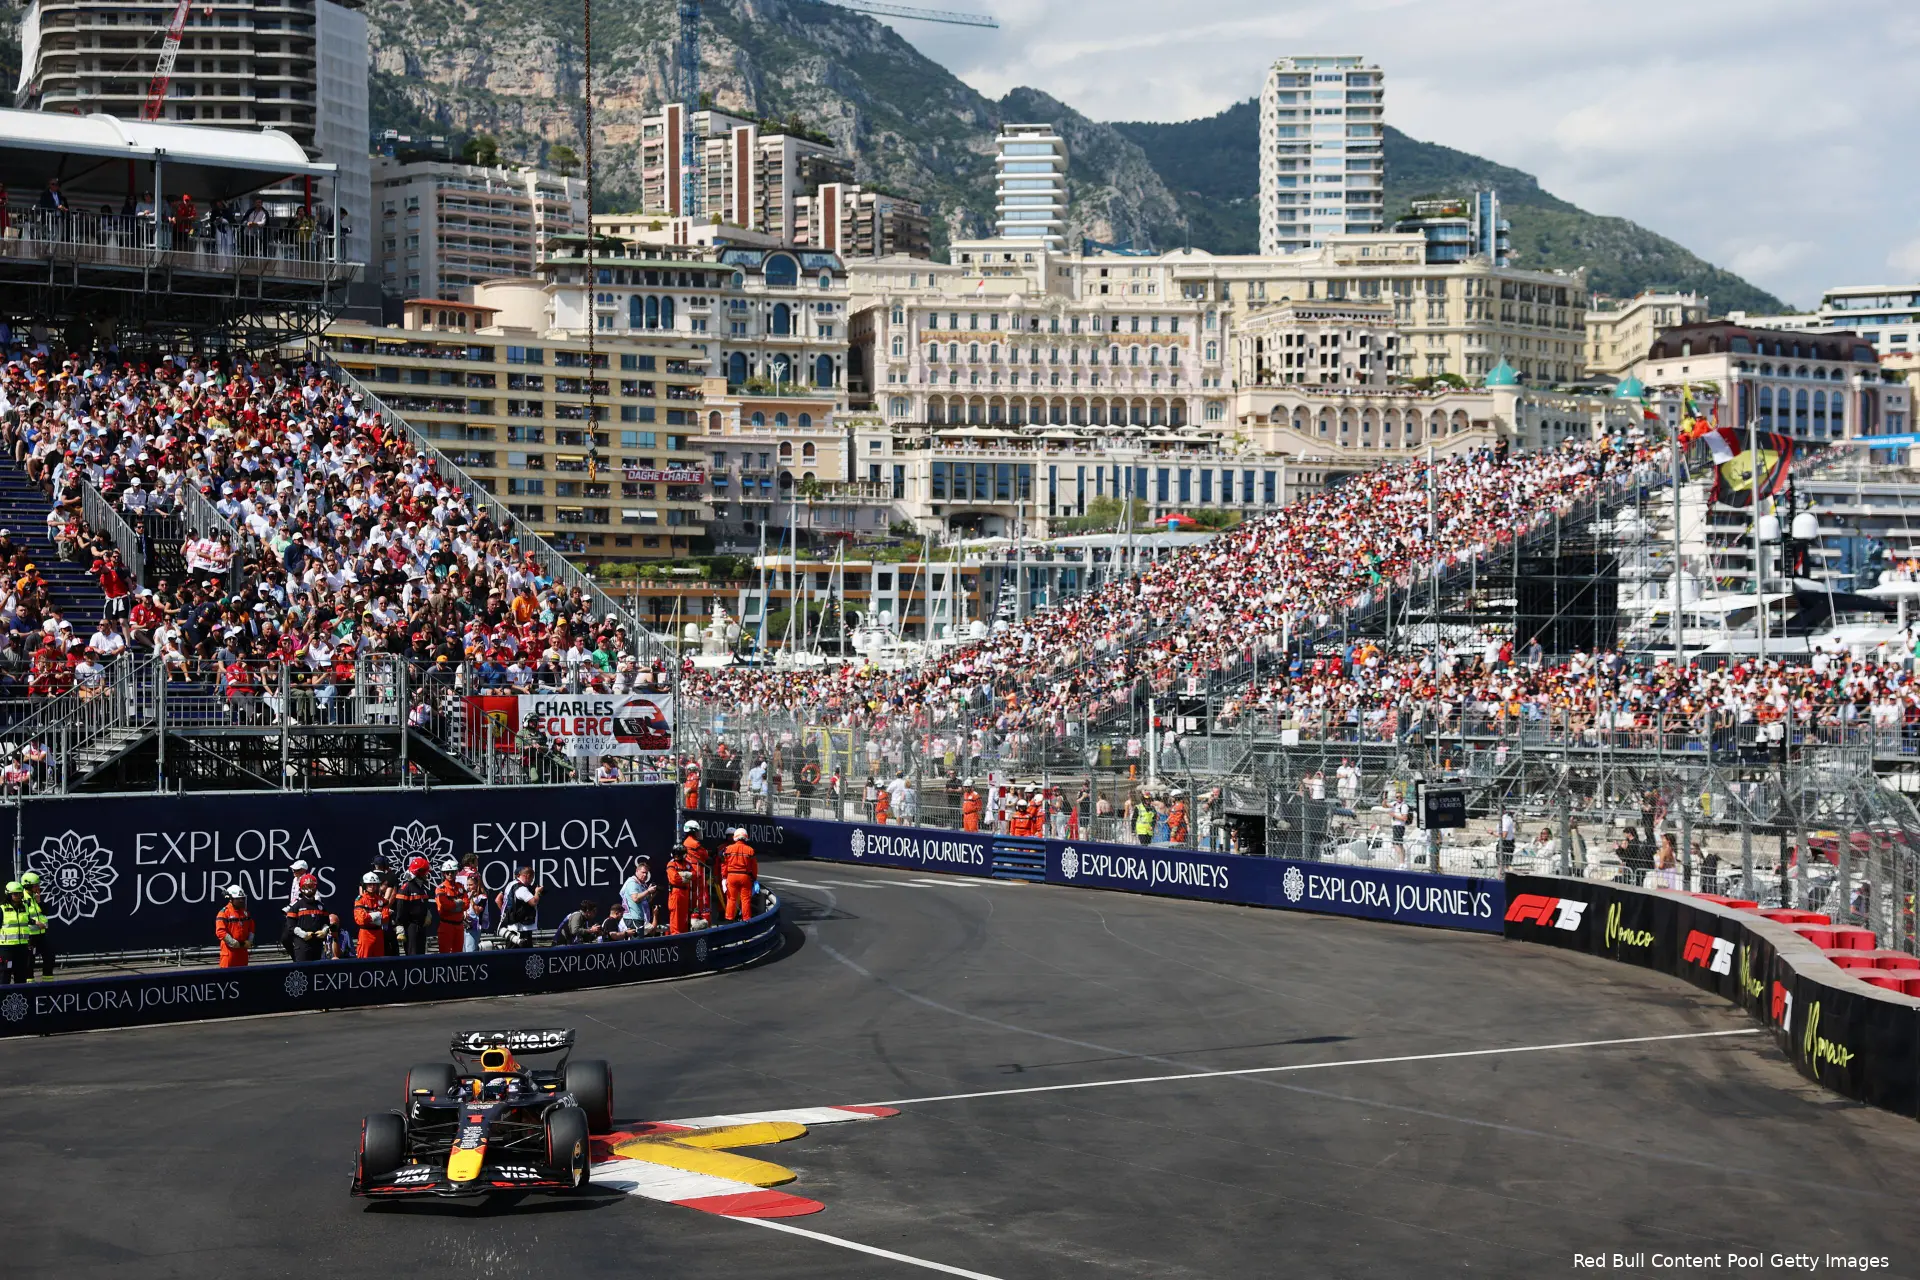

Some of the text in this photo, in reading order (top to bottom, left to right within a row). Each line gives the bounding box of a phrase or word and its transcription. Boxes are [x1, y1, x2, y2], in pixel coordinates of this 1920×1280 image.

[628, 470, 700, 481] DAGHE CHARLIE
[535, 701, 614, 717] CHARLES
[536, 717, 612, 736] ECLERC
[135, 828, 322, 866] EXPLORA
[473, 818, 638, 854] EXPLORA
[867, 834, 984, 865] EXPLORA JOURNEYS
[480, 854, 652, 892] OURNEYS
[1082, 853, 1229, 889] EXPLORA JOURNEYS
[129, 866, 336, 916] JOURNES
[1309, 875, 1492, 918] EXPLORA JOURNEYS
[1605, 901, 1655, 948] Monaco
[548, 946, 679, 974] EXPLORA JOURNEYS
[313, 964, 488, 991] EXPLORA JOURNEYS
[35, 981, 240, 1014] EXPLORA JOURNEYS
[1804, 1001, 1855, 1079] Monaco
[495, 1166, 542, 1179] VISA
